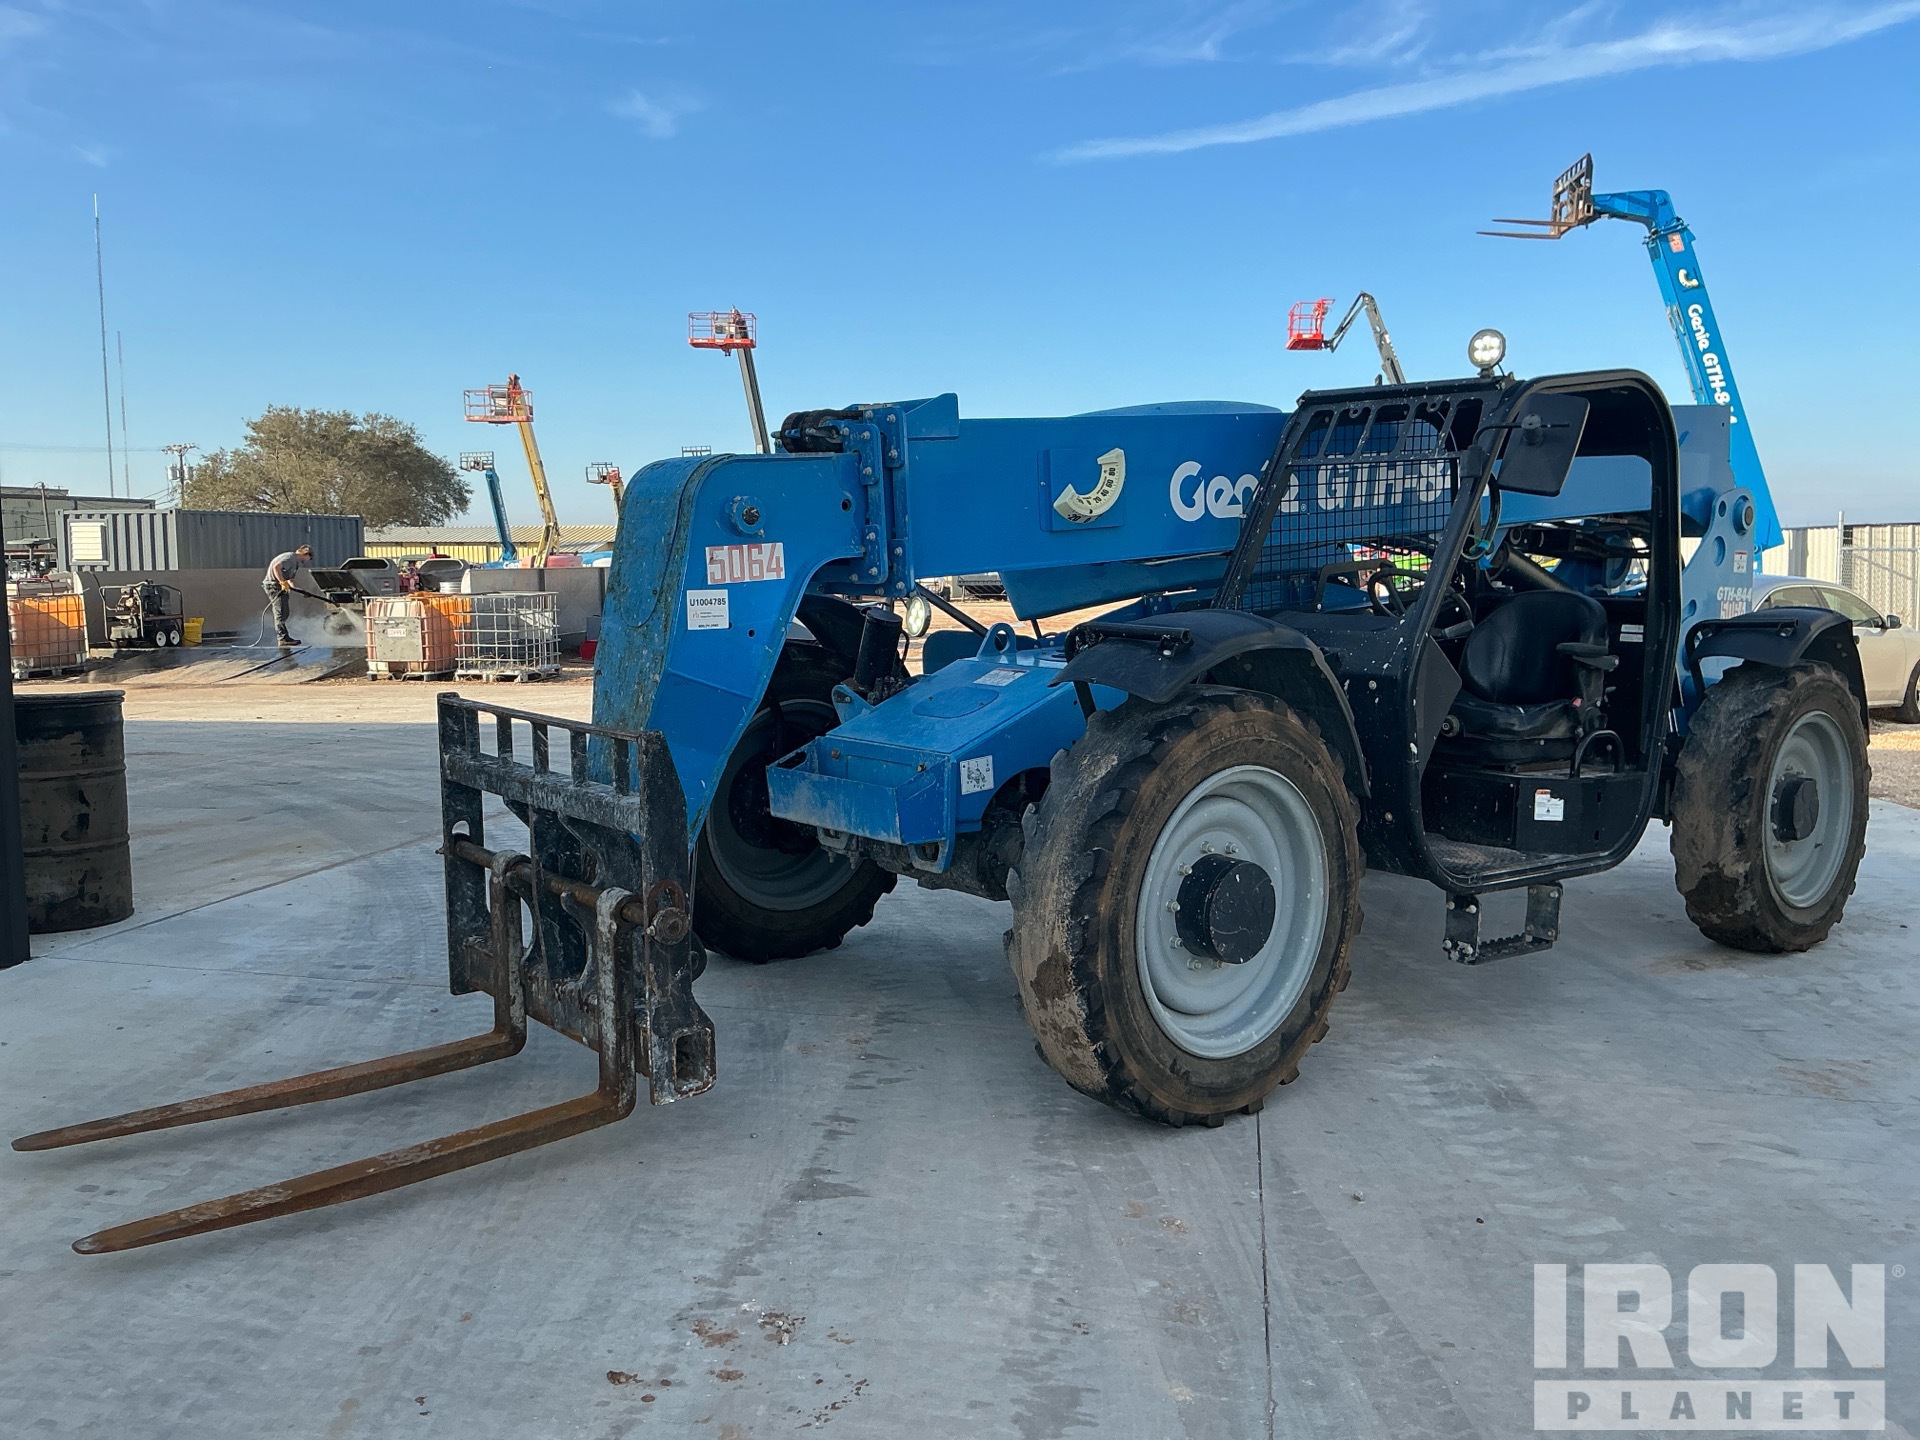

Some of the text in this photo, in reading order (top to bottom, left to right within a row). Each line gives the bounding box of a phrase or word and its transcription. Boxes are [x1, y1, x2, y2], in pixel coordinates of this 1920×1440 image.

[1688, 303, 1738, 424] Genie GTH-8
[1108, 467, 1116, 477] 80
[1105, 479, 1114, 488] 60
[1169, 459, 1299, 522] Gene
[708, 542, 784, 584] 5064
[1716, 586, 1753, 602] GTH-844
[689, 598, 727, 607] U1004785
